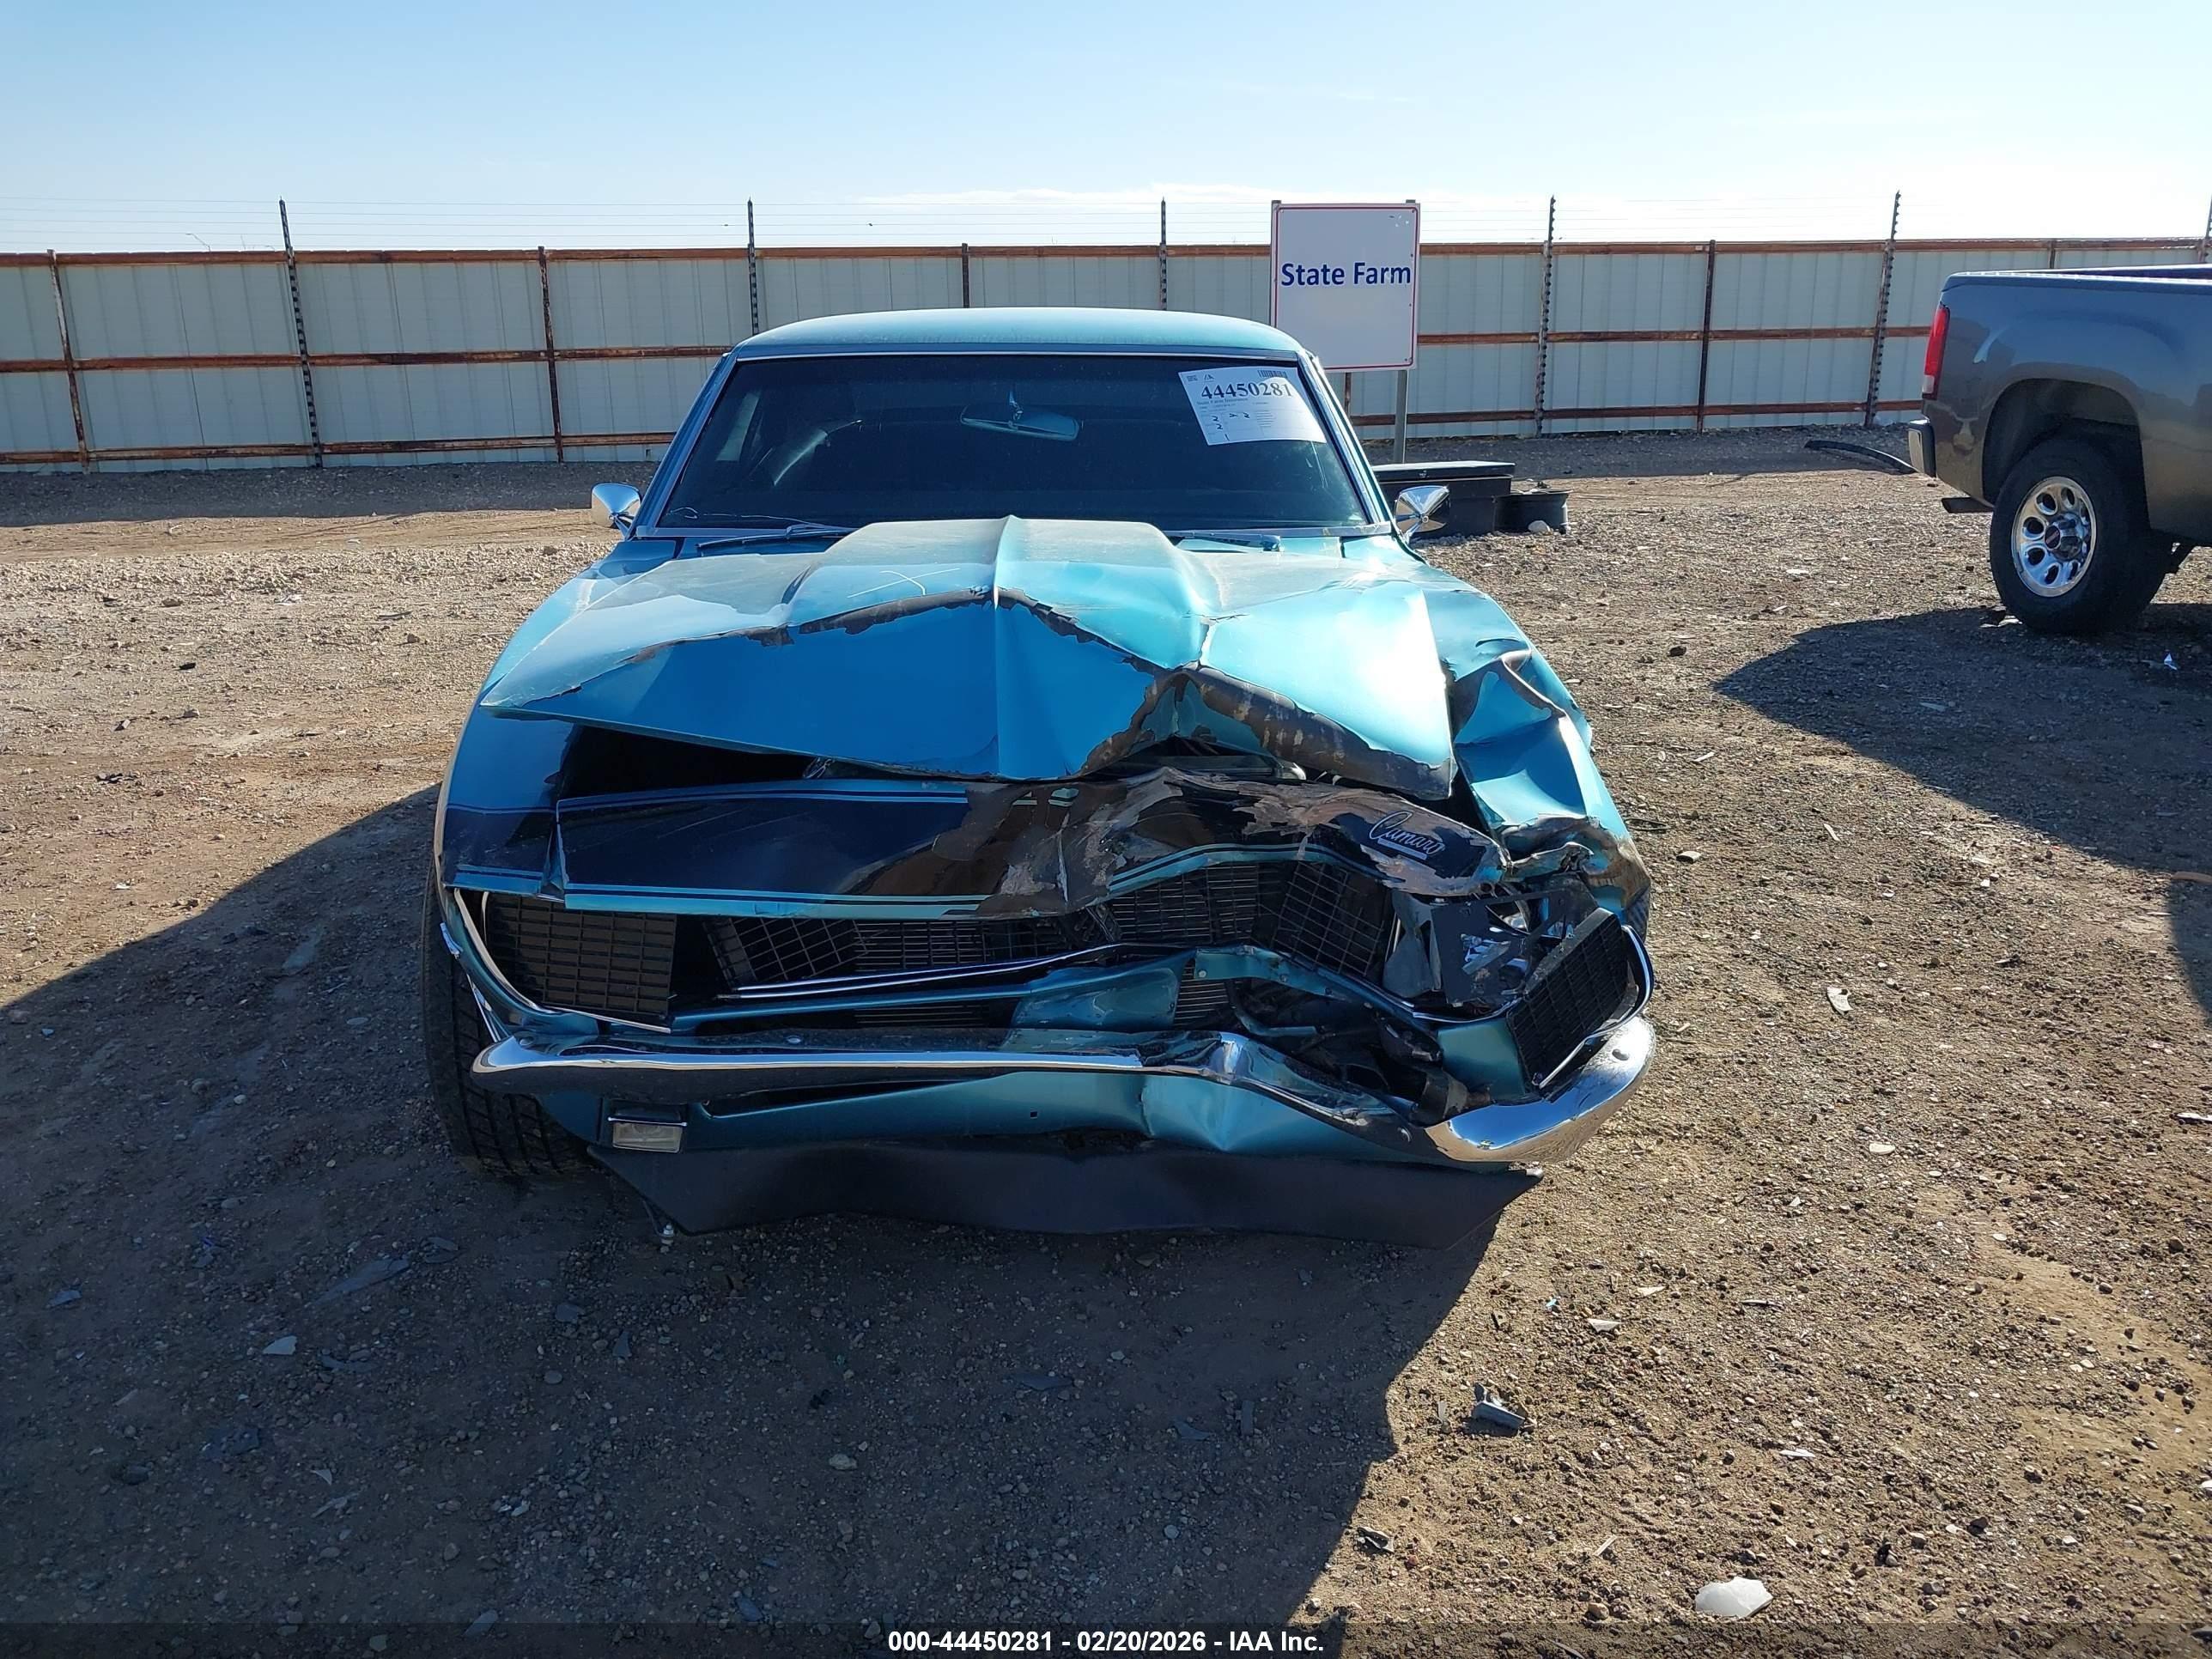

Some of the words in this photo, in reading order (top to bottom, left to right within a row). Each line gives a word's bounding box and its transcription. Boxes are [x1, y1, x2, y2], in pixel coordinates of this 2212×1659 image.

[1281, 263, 1345, 286] State
[1353, 262, 1411, 285] Farm
[1201, 381, 1292, 399] 44450281
[1370, 811, 1445, 854] Camaro
